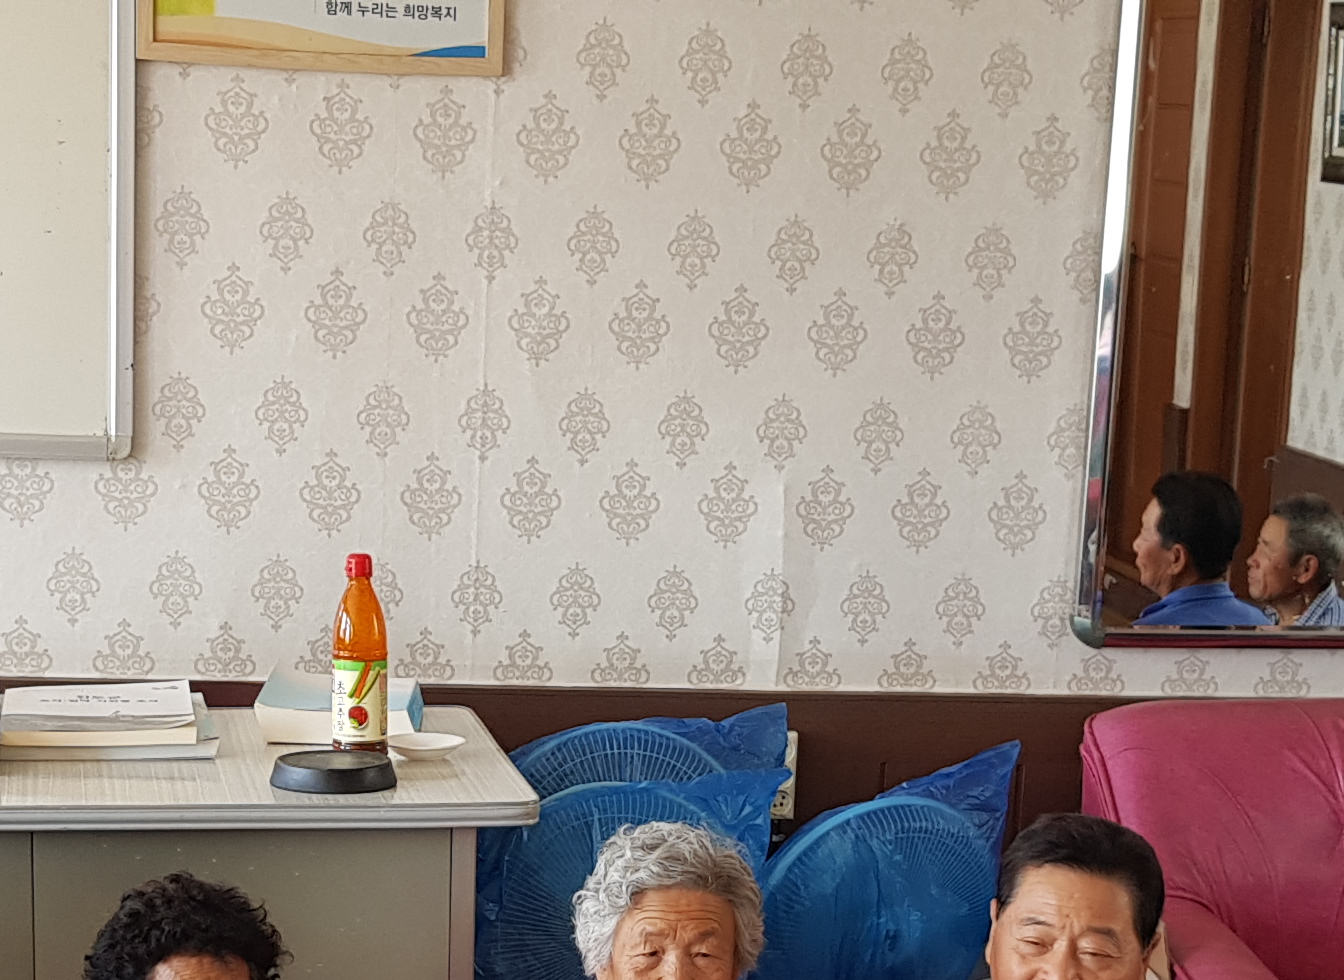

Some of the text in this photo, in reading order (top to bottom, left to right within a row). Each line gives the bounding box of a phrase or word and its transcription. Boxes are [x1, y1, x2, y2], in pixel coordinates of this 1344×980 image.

[325, 0, 458, 22] 함께 누리는 희망복지
[335, 680, 348, 732] 초고추장
